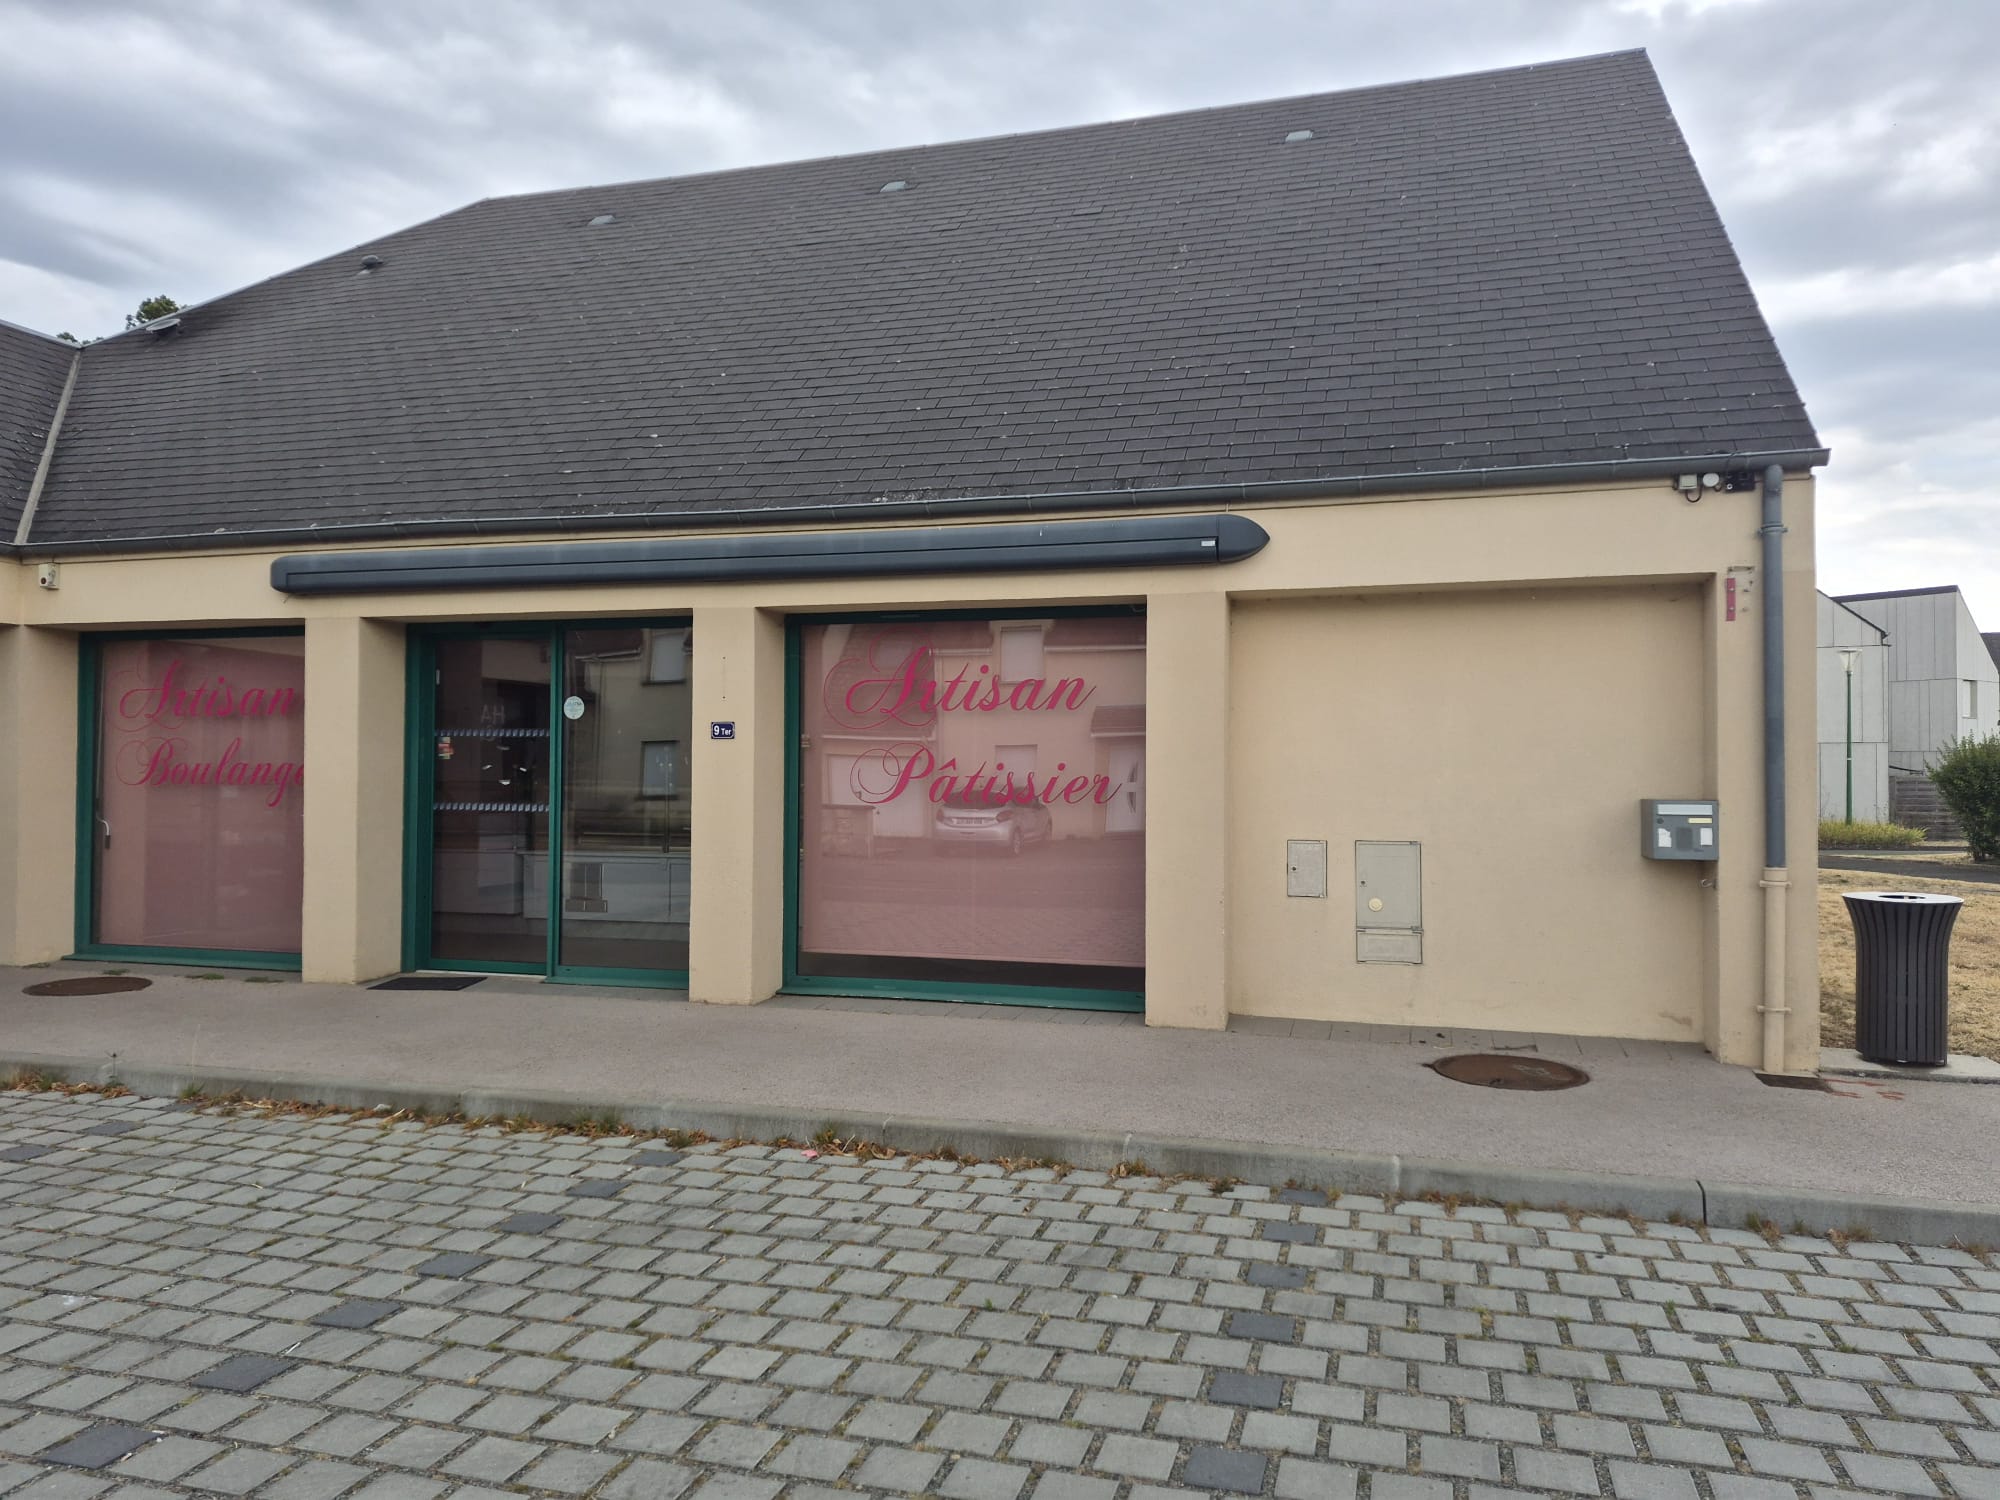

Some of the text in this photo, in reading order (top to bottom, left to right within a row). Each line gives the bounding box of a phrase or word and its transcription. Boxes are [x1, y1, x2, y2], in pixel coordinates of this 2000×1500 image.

[107, 657, 295, 732] Artisan
[824, 628, 1097, 730] Artisan
[713, 725, 732, 736] 9 Ter
[850, 742, 1122, 804] Pâtissier
